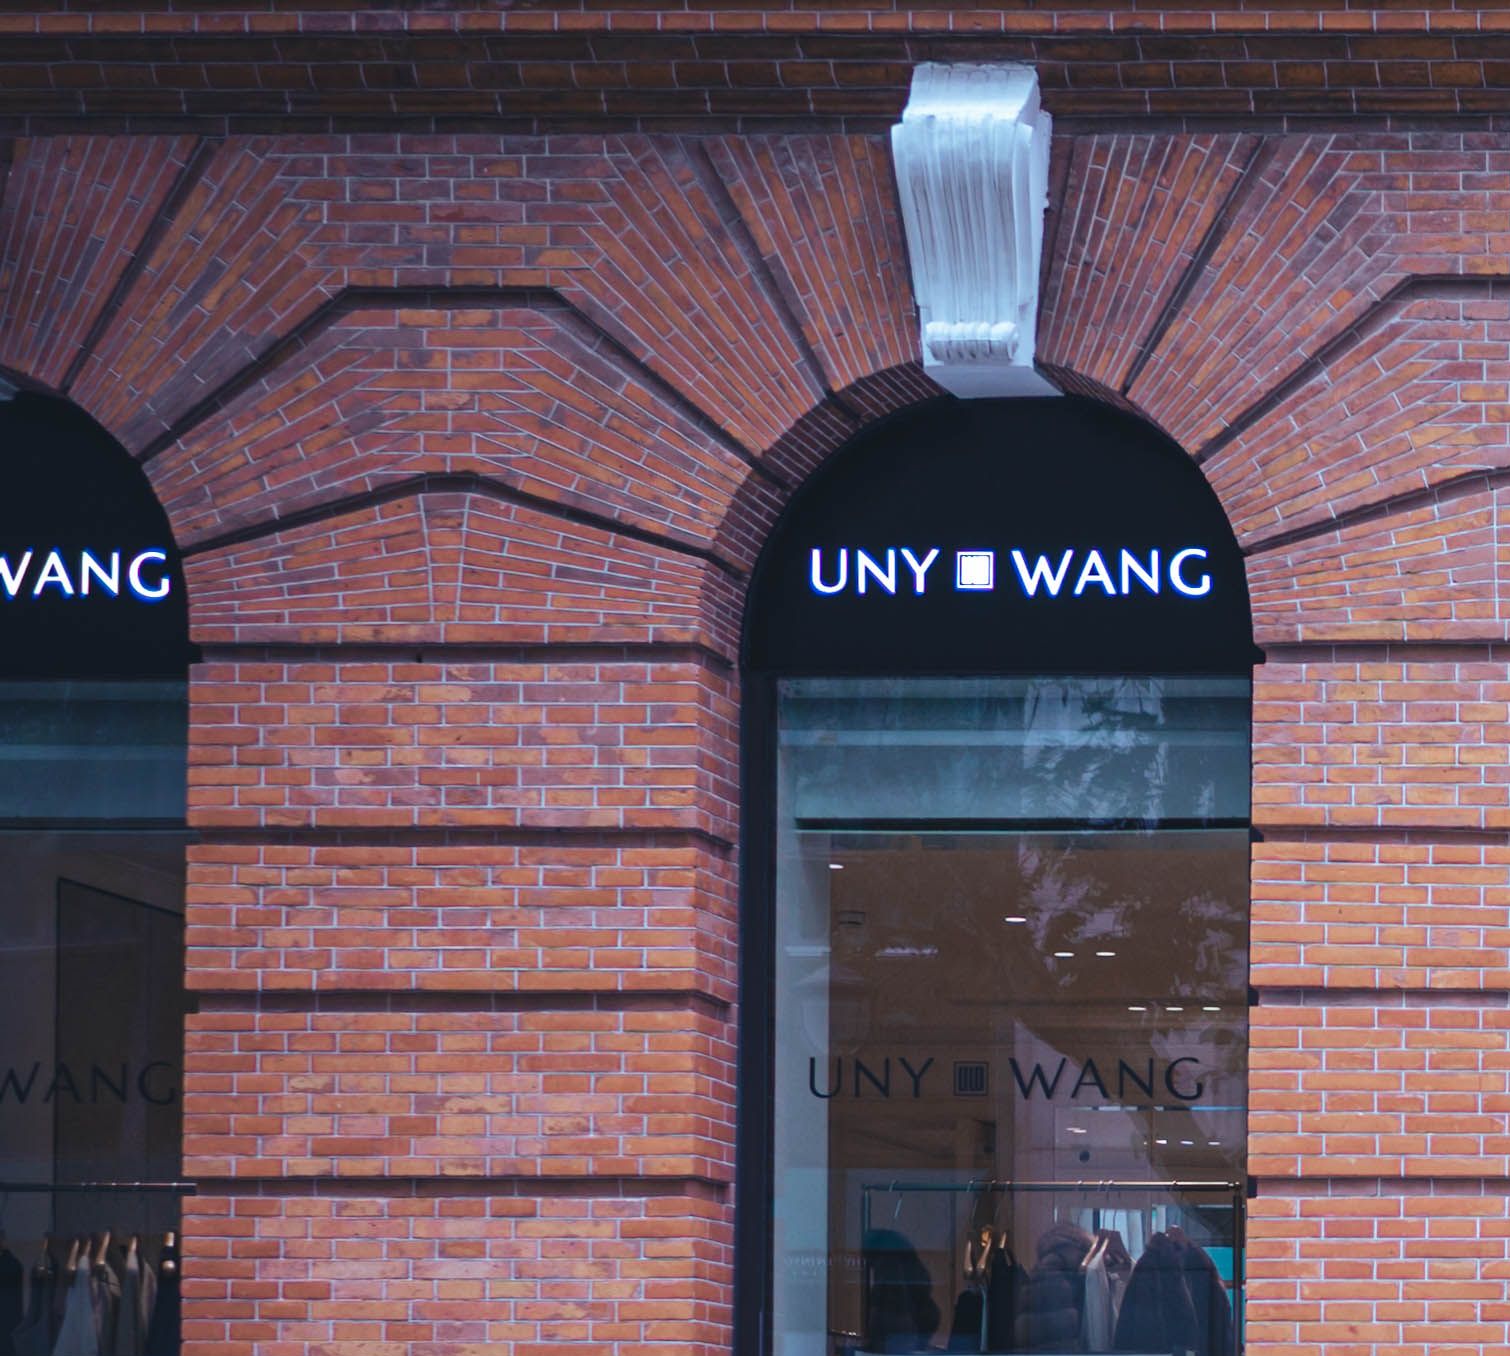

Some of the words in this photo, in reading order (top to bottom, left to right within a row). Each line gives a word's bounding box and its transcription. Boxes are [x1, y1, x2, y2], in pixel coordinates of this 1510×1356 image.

[811, 548, 939, 596] UNY
[1011, 548, 1212, 597] WANG
[0, 1060, 176, 1105] WANG
[809, 1056, 936, 1100] UNY
[1008, 1056, 1204, 1101] WANG
